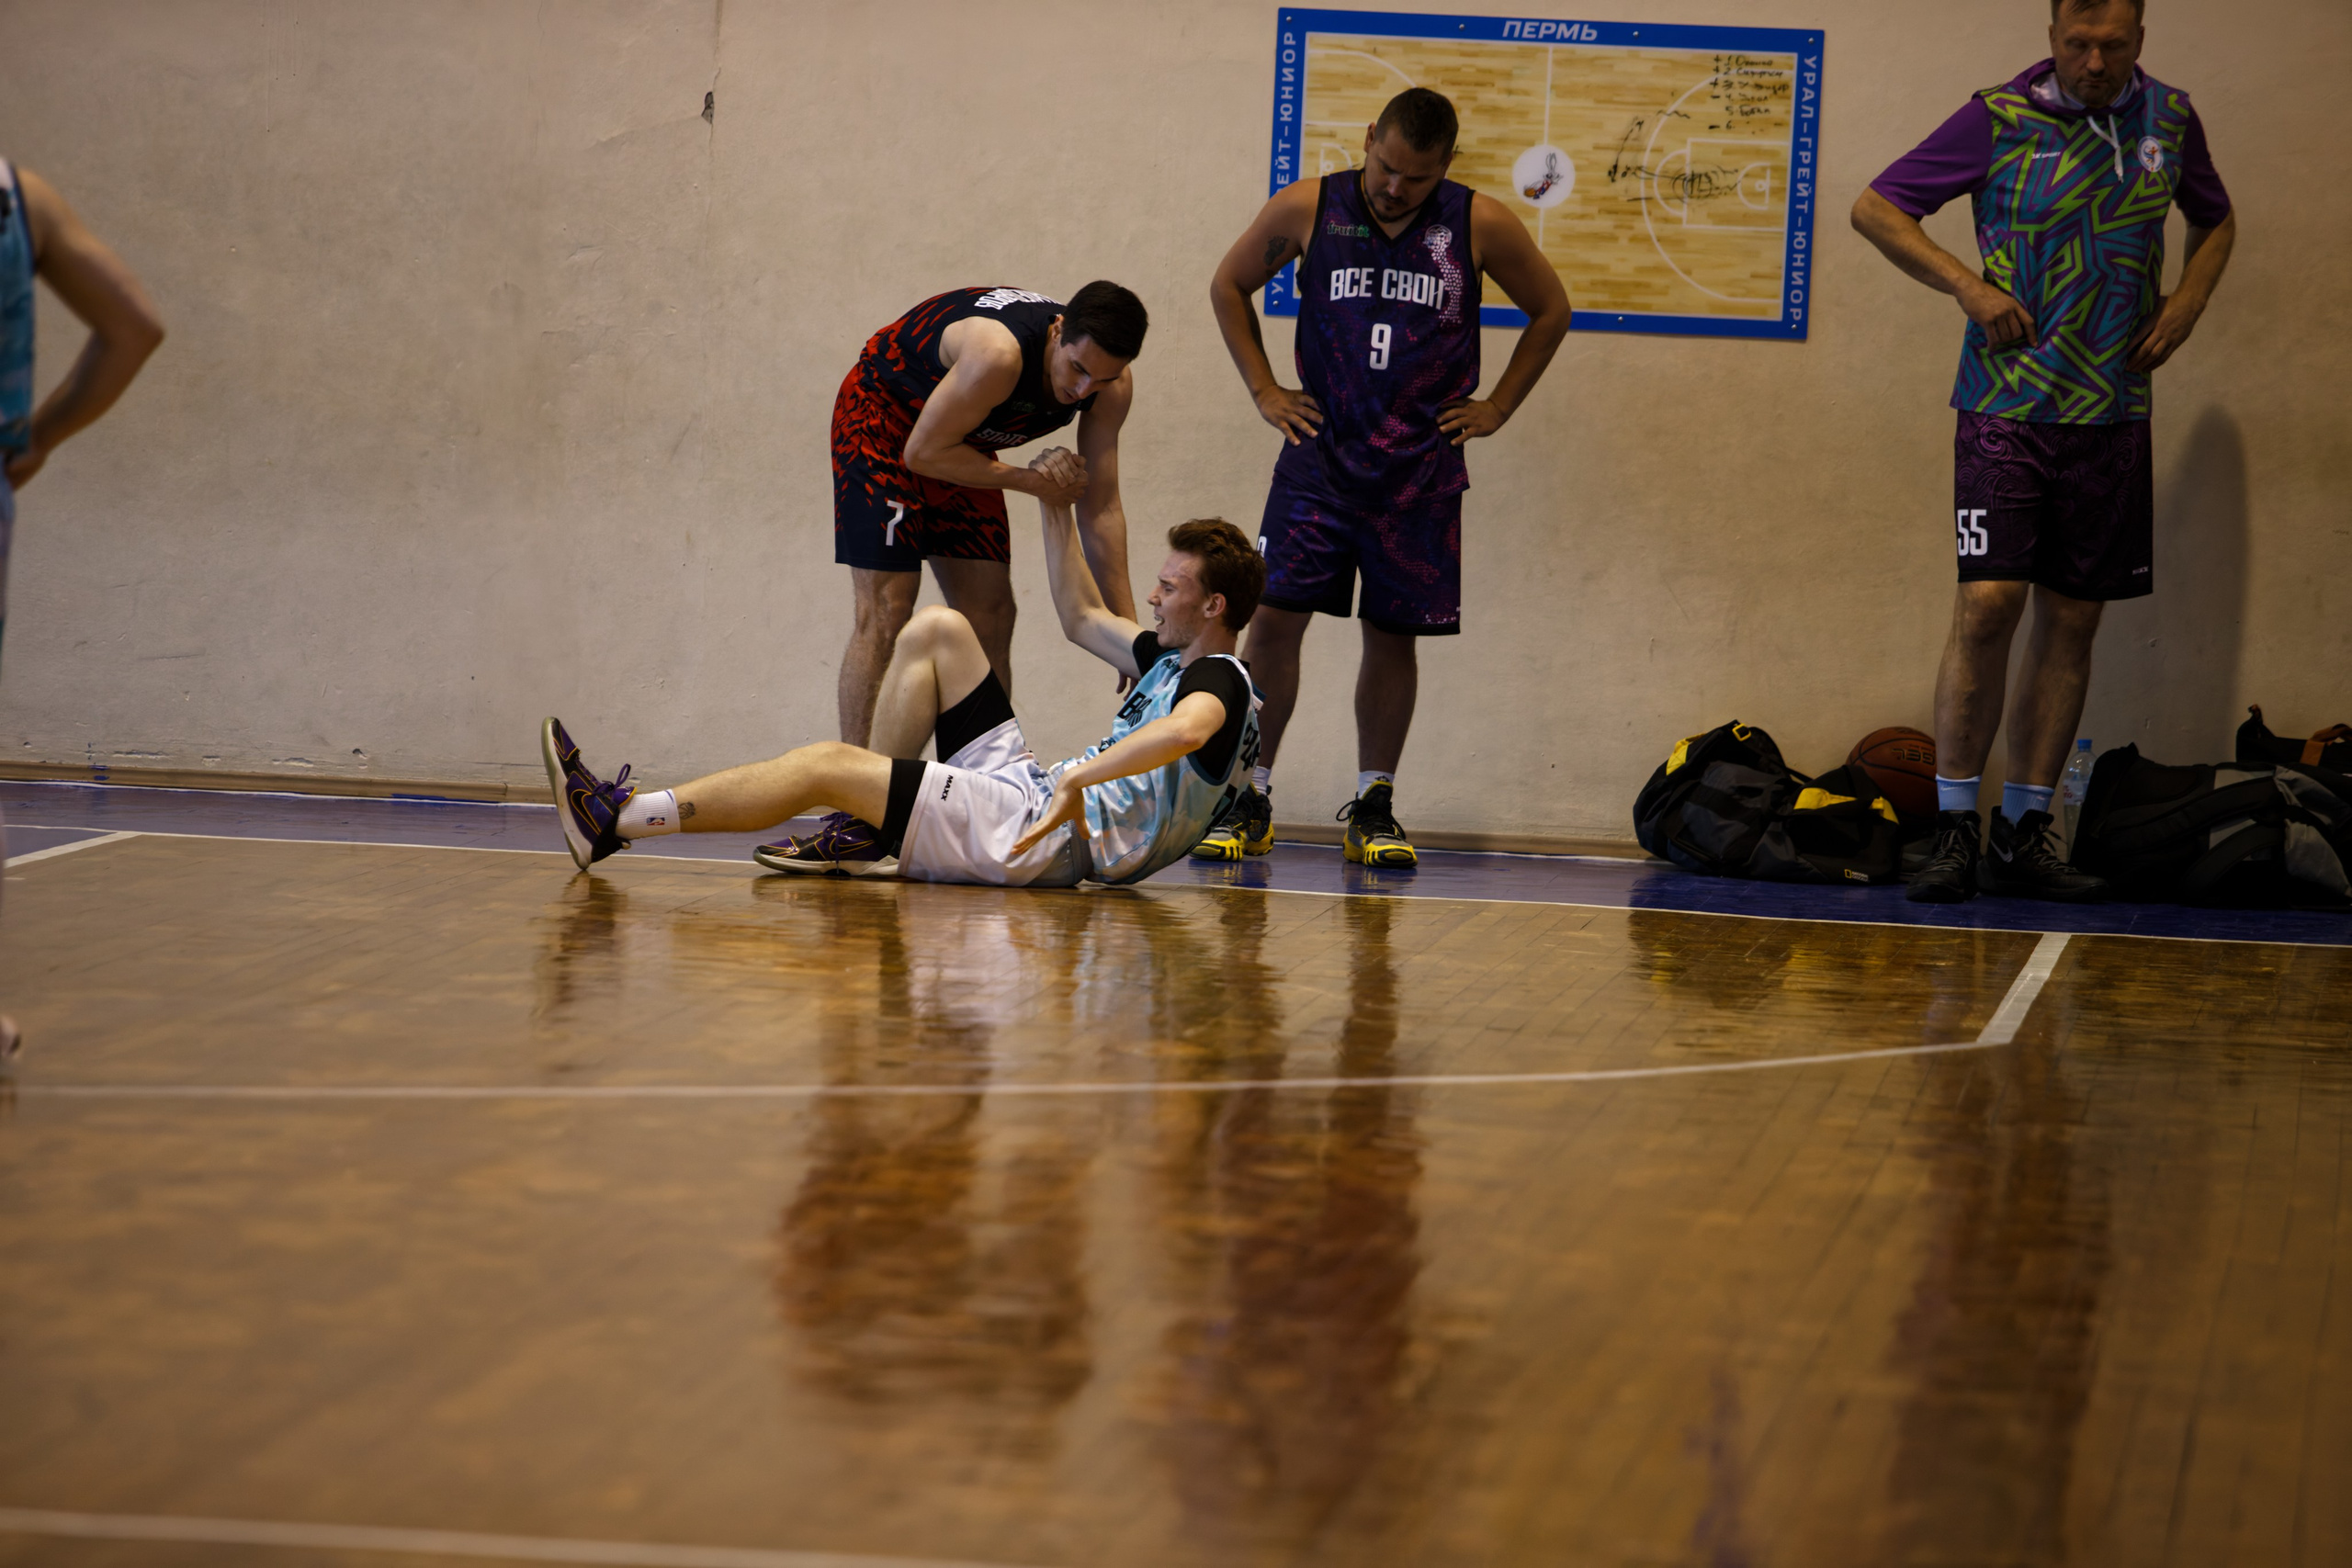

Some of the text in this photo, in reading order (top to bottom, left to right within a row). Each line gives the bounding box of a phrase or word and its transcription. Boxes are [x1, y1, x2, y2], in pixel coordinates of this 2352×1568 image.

[1502, 20, 1598, 41] ПЕРМЬ
[1790, 55, 1817, 321] УРАЛ-ГРЕЙТ-ЮНИОР
[1330, 267, 1444, 310] ВСЕ СВОИ
[1369, 323, 1392, 370] 9
[886, 500, 904, 546] 7
[1957, 509, 1988, 556] 55
[1892, 748, 1935, 766] GEL
[941, 774, 954, 802] MAXX
